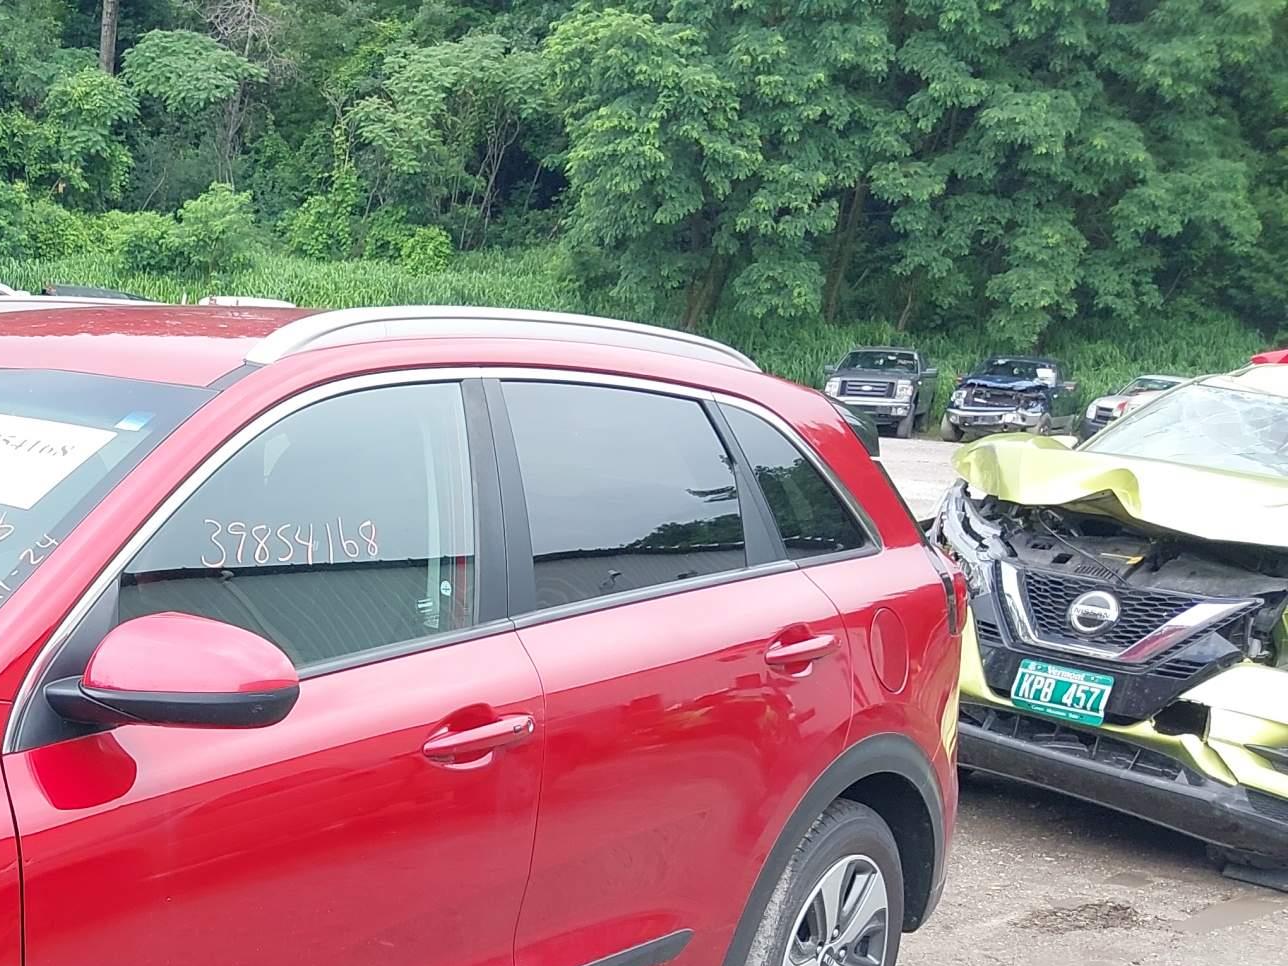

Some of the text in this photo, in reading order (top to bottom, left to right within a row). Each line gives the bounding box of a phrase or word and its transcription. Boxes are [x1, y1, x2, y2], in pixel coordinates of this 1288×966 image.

[201, 516, 378, 568] 39854168
[1019, 673, 1056, 703] KPB
[1062, 683, 1101, 712] 457
